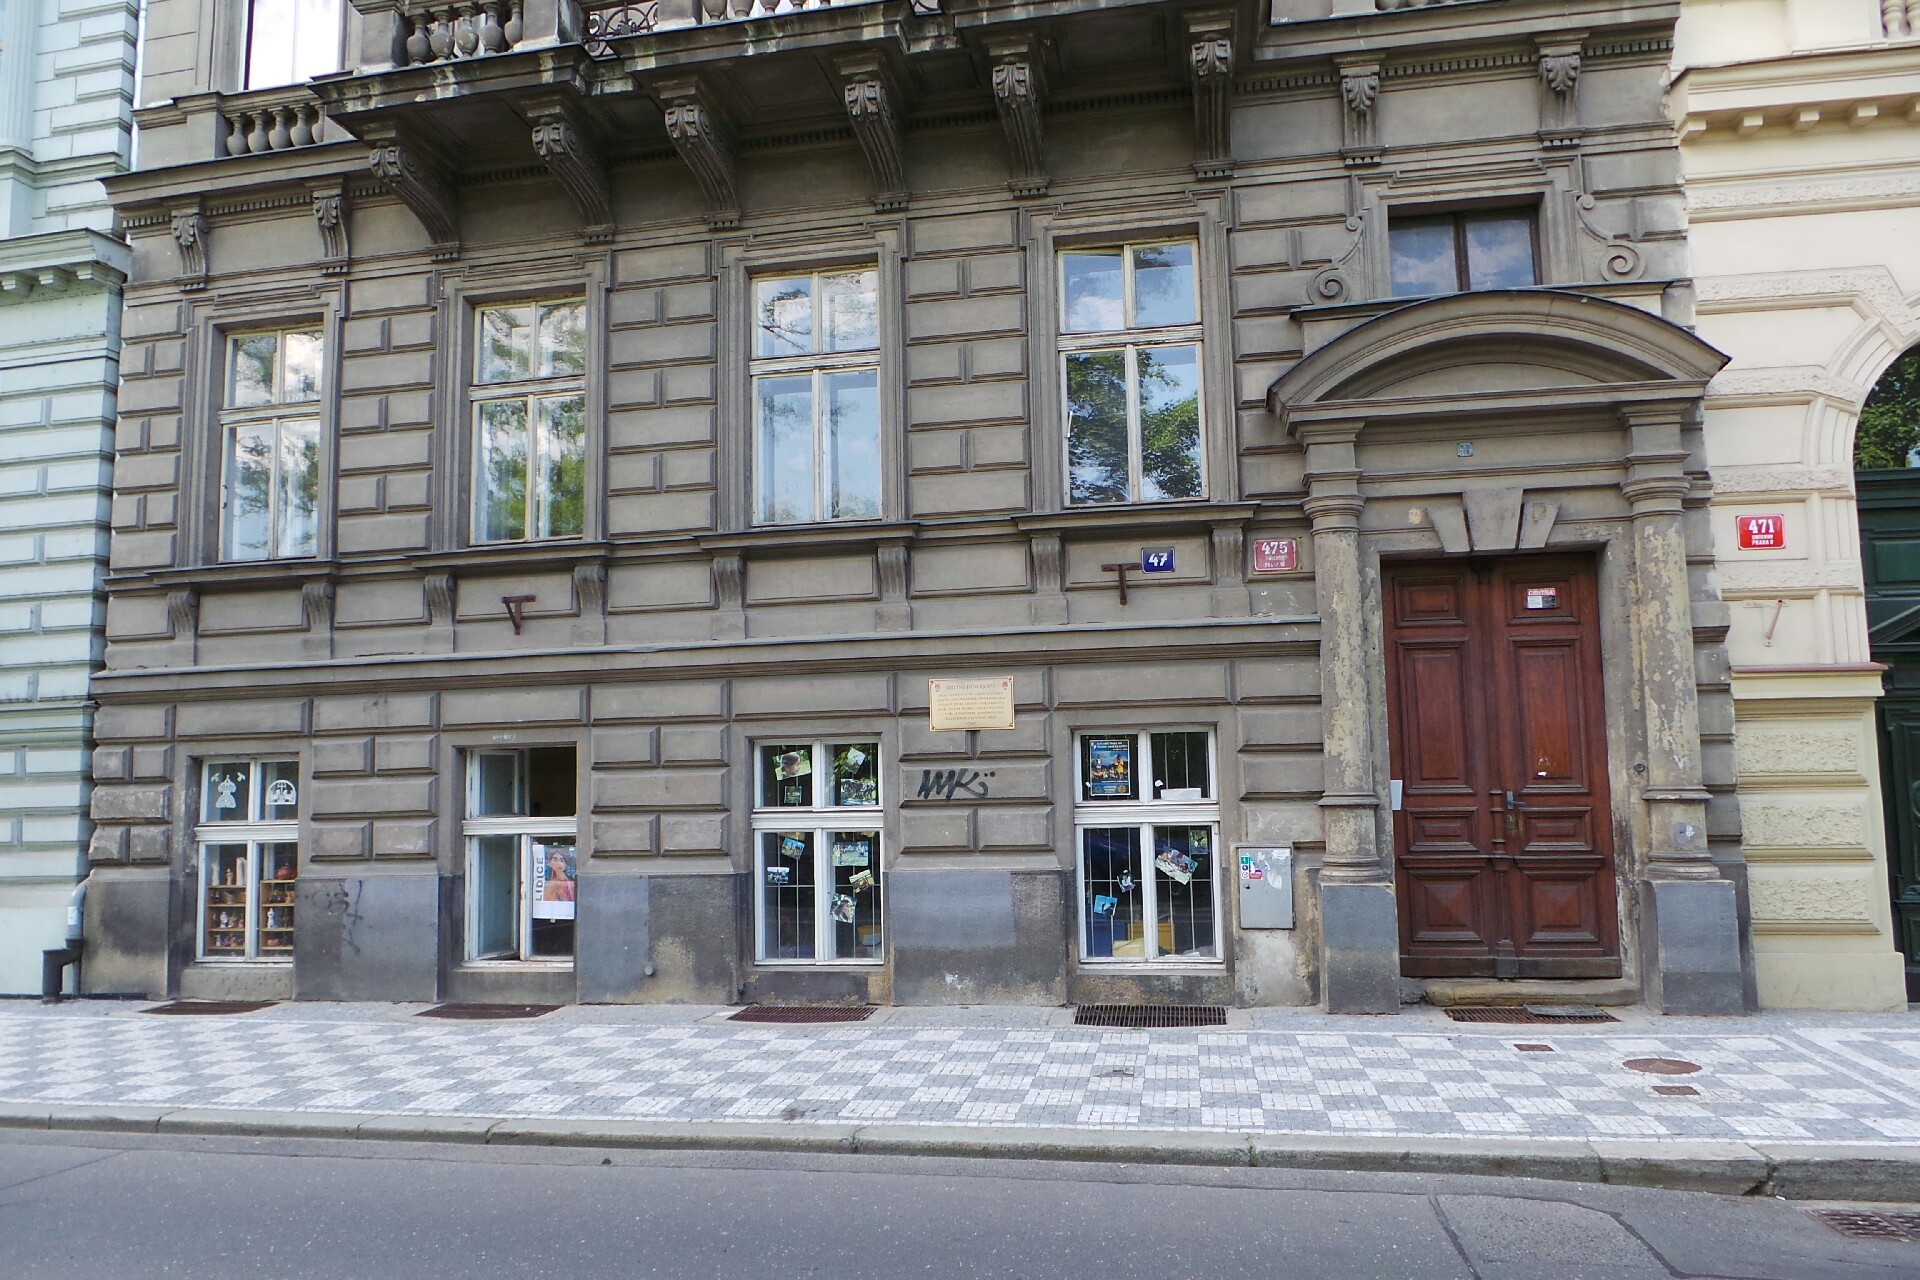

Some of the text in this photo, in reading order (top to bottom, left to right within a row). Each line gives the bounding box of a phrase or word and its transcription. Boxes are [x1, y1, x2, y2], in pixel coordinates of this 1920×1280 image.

[1748, 519, 1775, 534] 471
[1261, 541, 1288, 555] 475
[1148, 552, 1168, 567] 47
[535, 857, 544, 902] LIDICE
